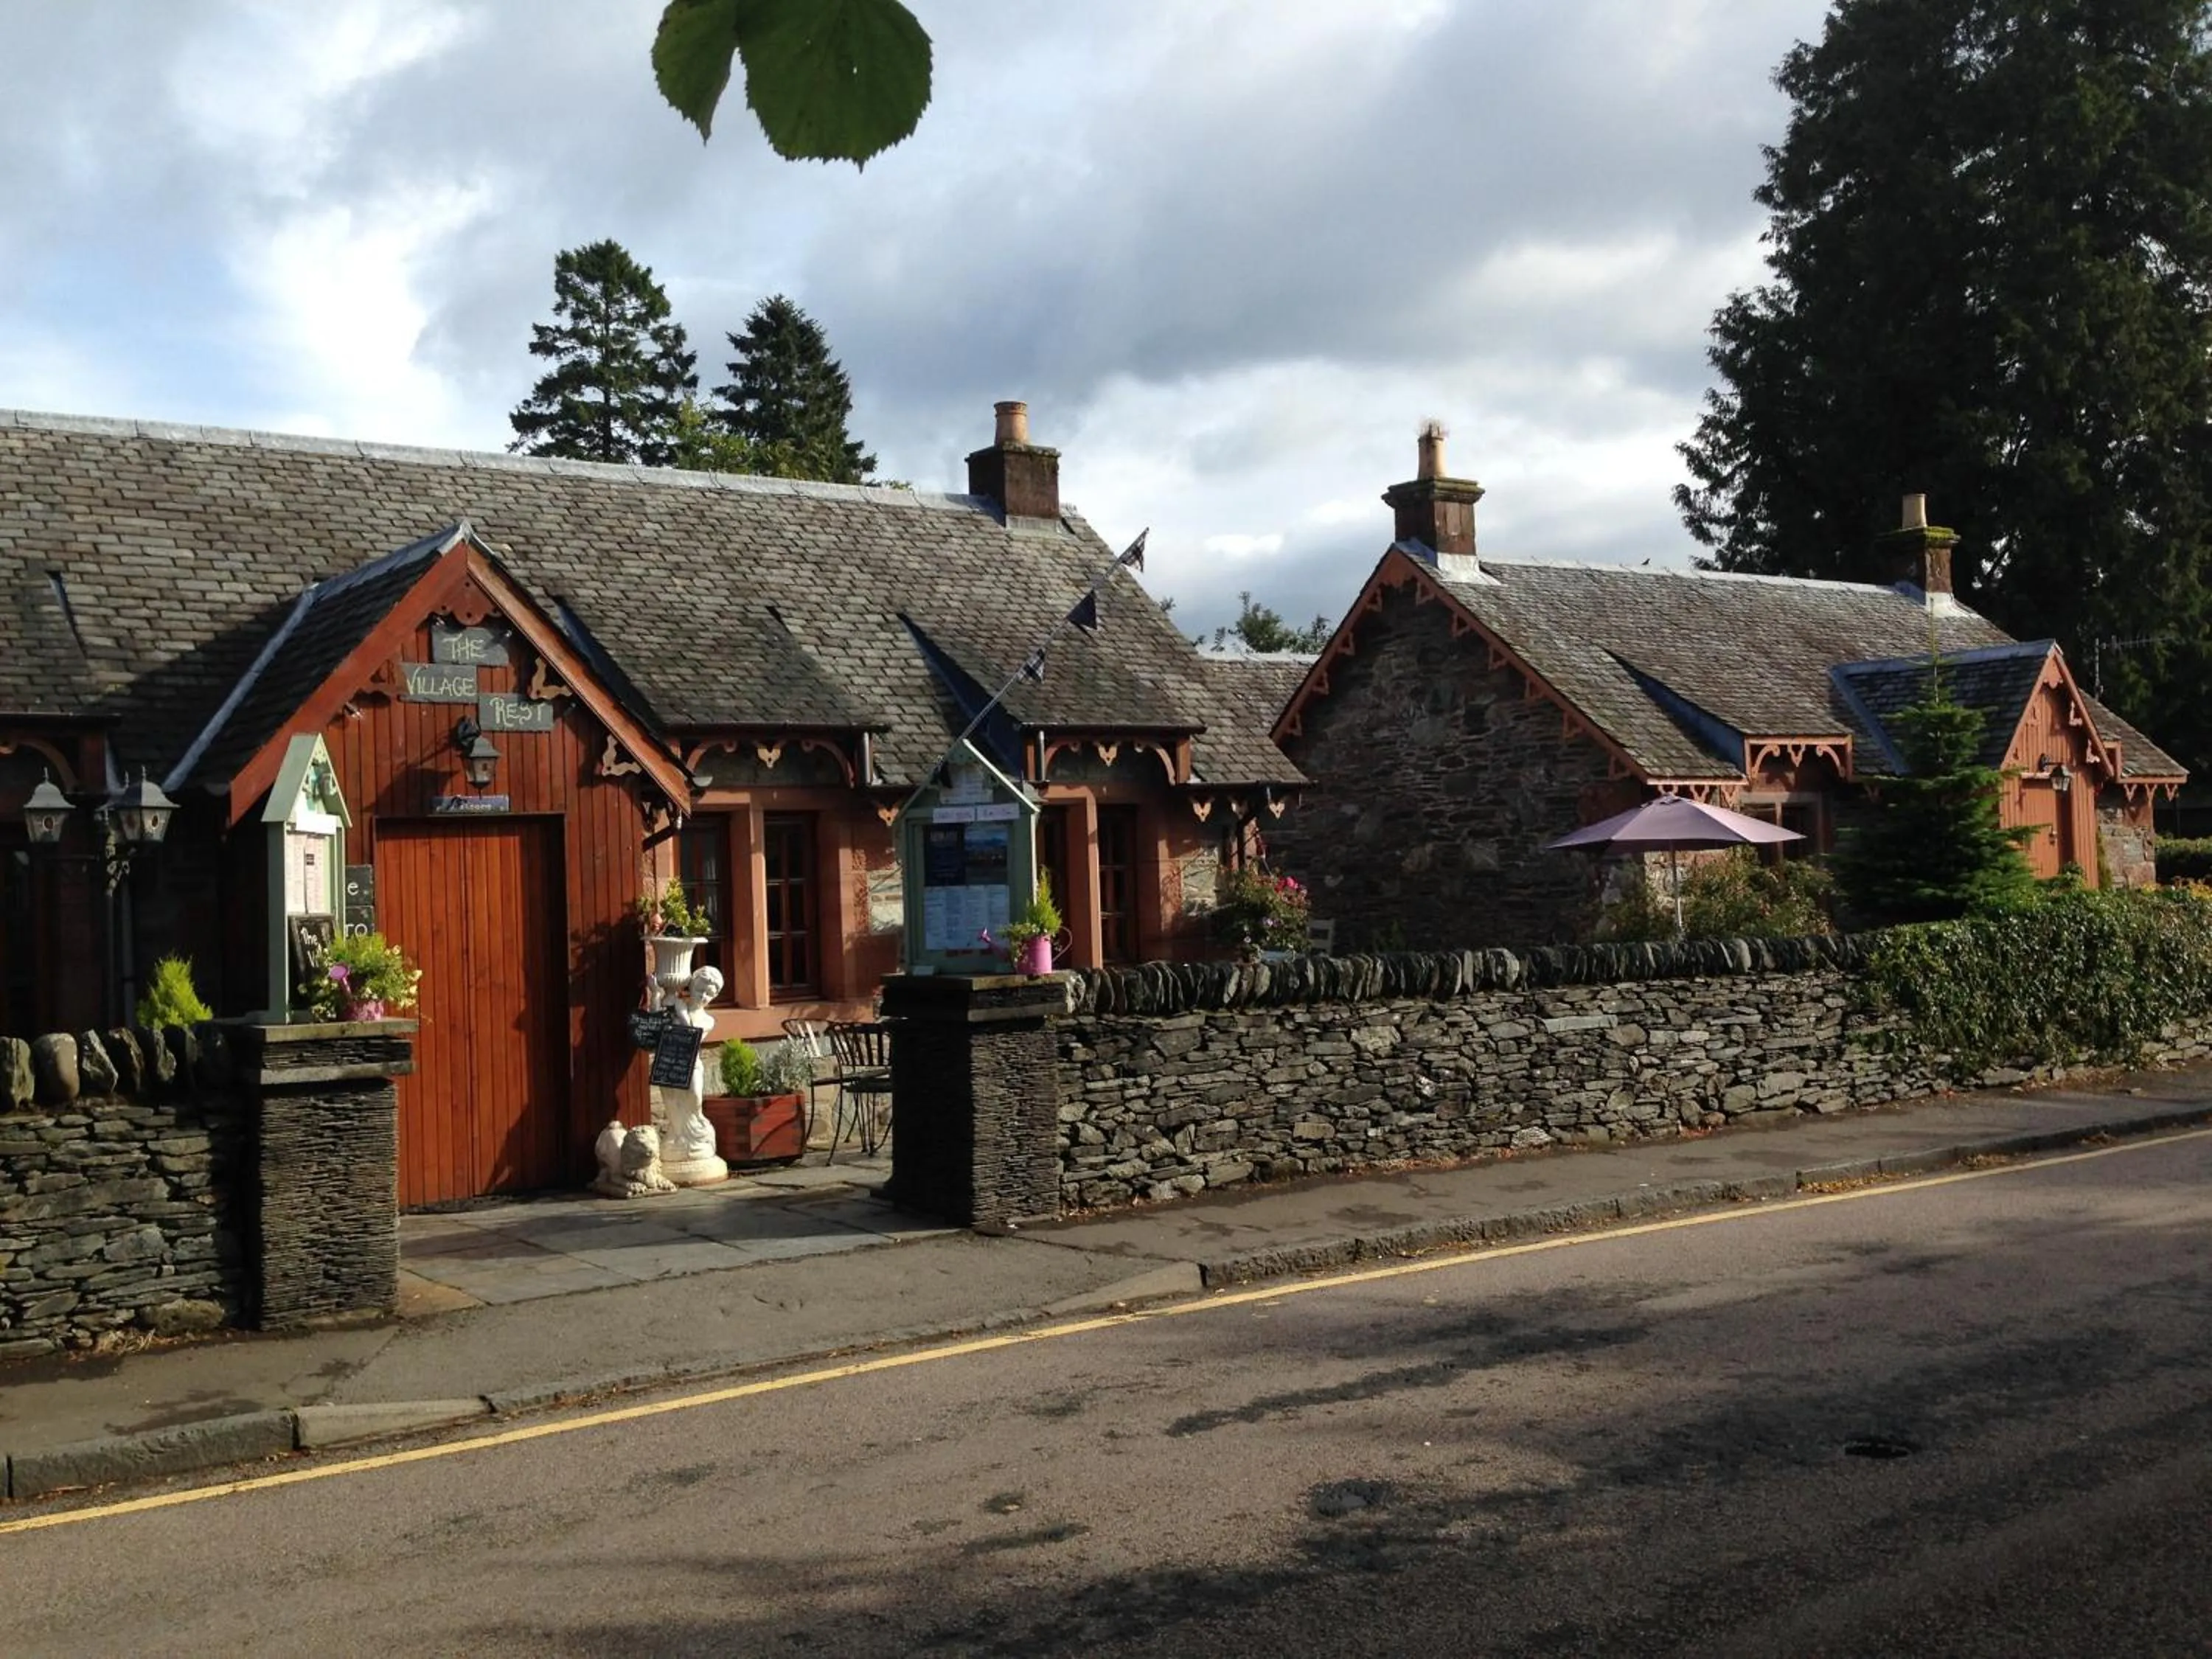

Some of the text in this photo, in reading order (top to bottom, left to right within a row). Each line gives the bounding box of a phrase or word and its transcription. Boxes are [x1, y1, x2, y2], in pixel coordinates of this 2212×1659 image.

[442, 633, 487, 661] THE
[406, 666, 476, 697] VILLAGE
[489, 696, 546, 727] REST
